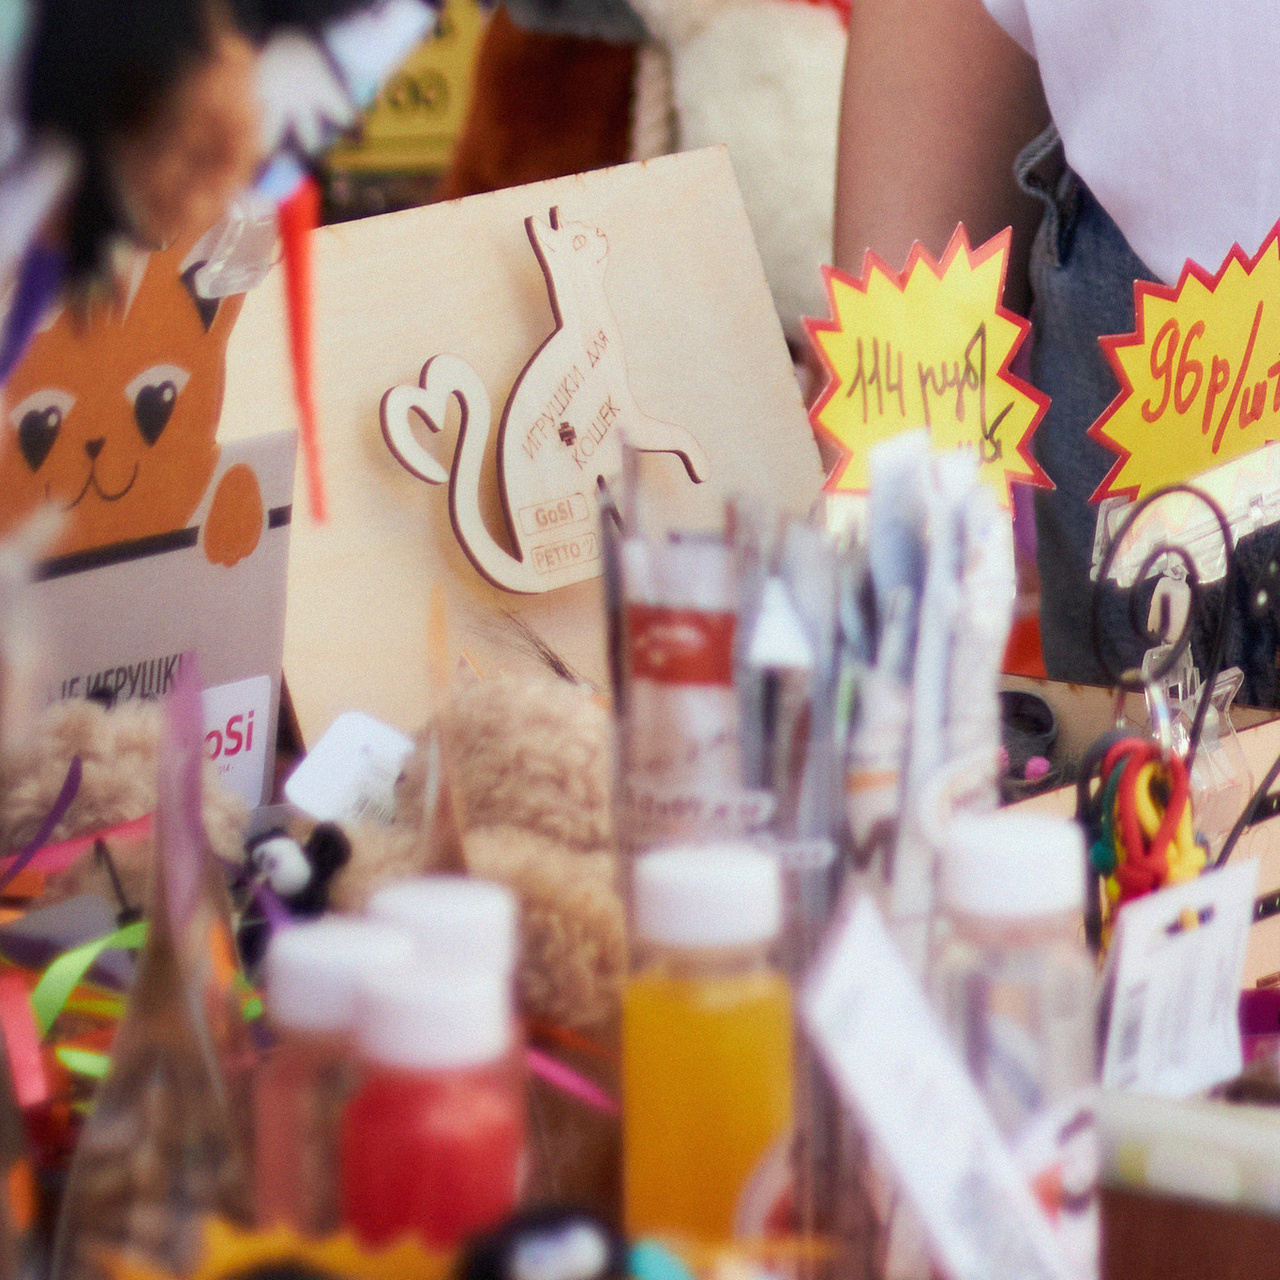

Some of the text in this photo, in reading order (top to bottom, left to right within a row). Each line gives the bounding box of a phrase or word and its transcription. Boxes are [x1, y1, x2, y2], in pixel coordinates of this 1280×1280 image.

[522, 329, 609, 460] ИГРУШКИ ДЛЯ
[847, 337, 906, 424] 114
[571, 395, 621, 470] КОШЕК
[204, 709, 255, 761] oSi
